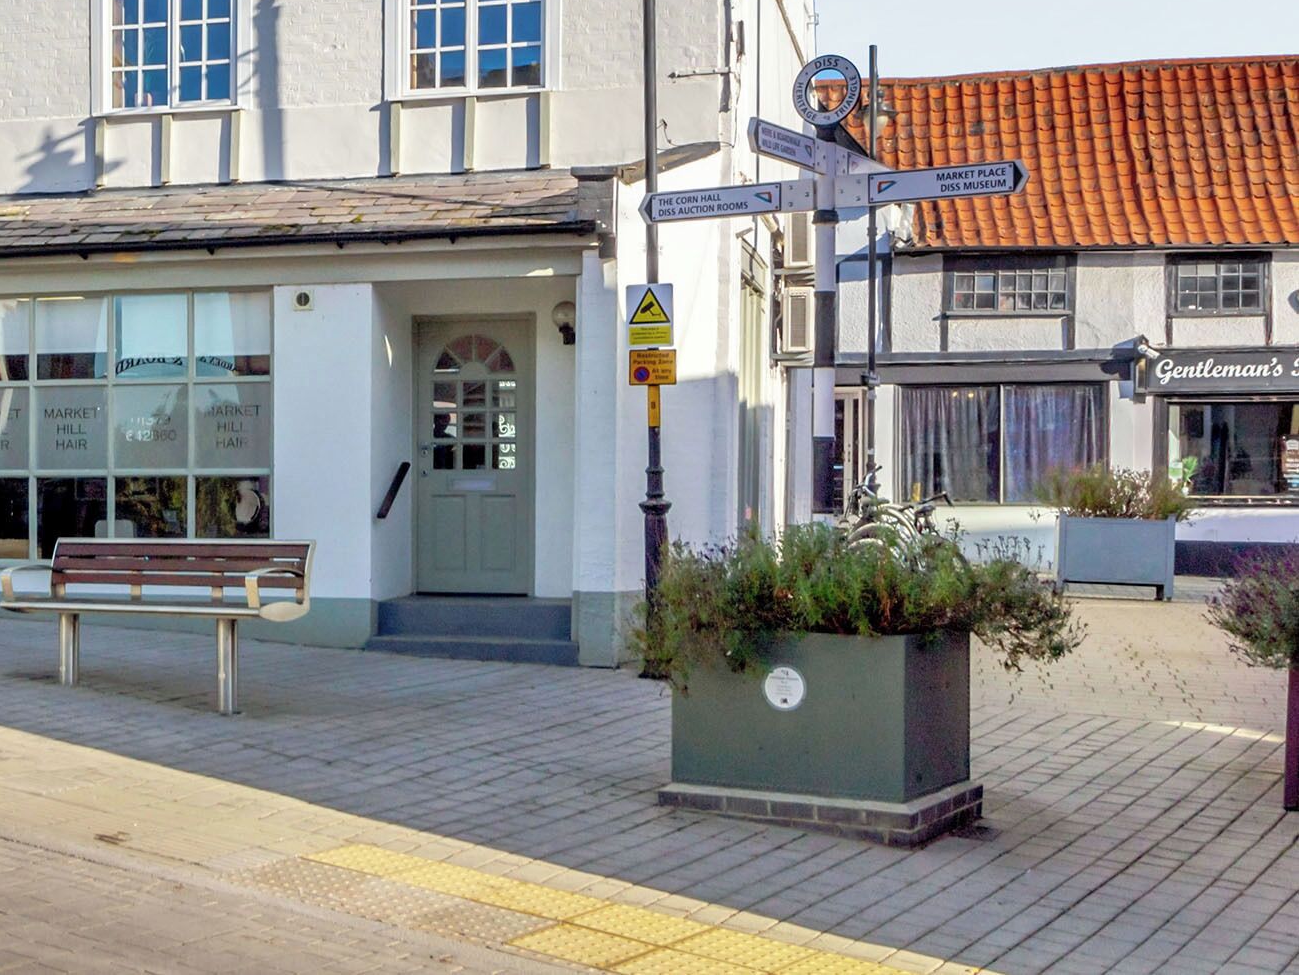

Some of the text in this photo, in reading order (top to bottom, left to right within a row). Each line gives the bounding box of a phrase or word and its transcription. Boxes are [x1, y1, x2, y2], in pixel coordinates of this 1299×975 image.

[814, 57, 840, 69] DISS
[795, 75, 858, 122] HERITAGE TRIANGLE
[936, 167, 1006, 181] MARKET PLACE
[940, 179, 1007, 192] DISS MUSEUM
[658, 194, 721, 207] THE CORN HALL
[658, 201, 749, 217] DISS AUCTION ROOMS
[1155, 357, 1283, 384] Gentleman's
[44, 408, 98, 419] MARKET
[56, 424, 87, 435] HILL
[55, 439, 88, 450] HAIR
